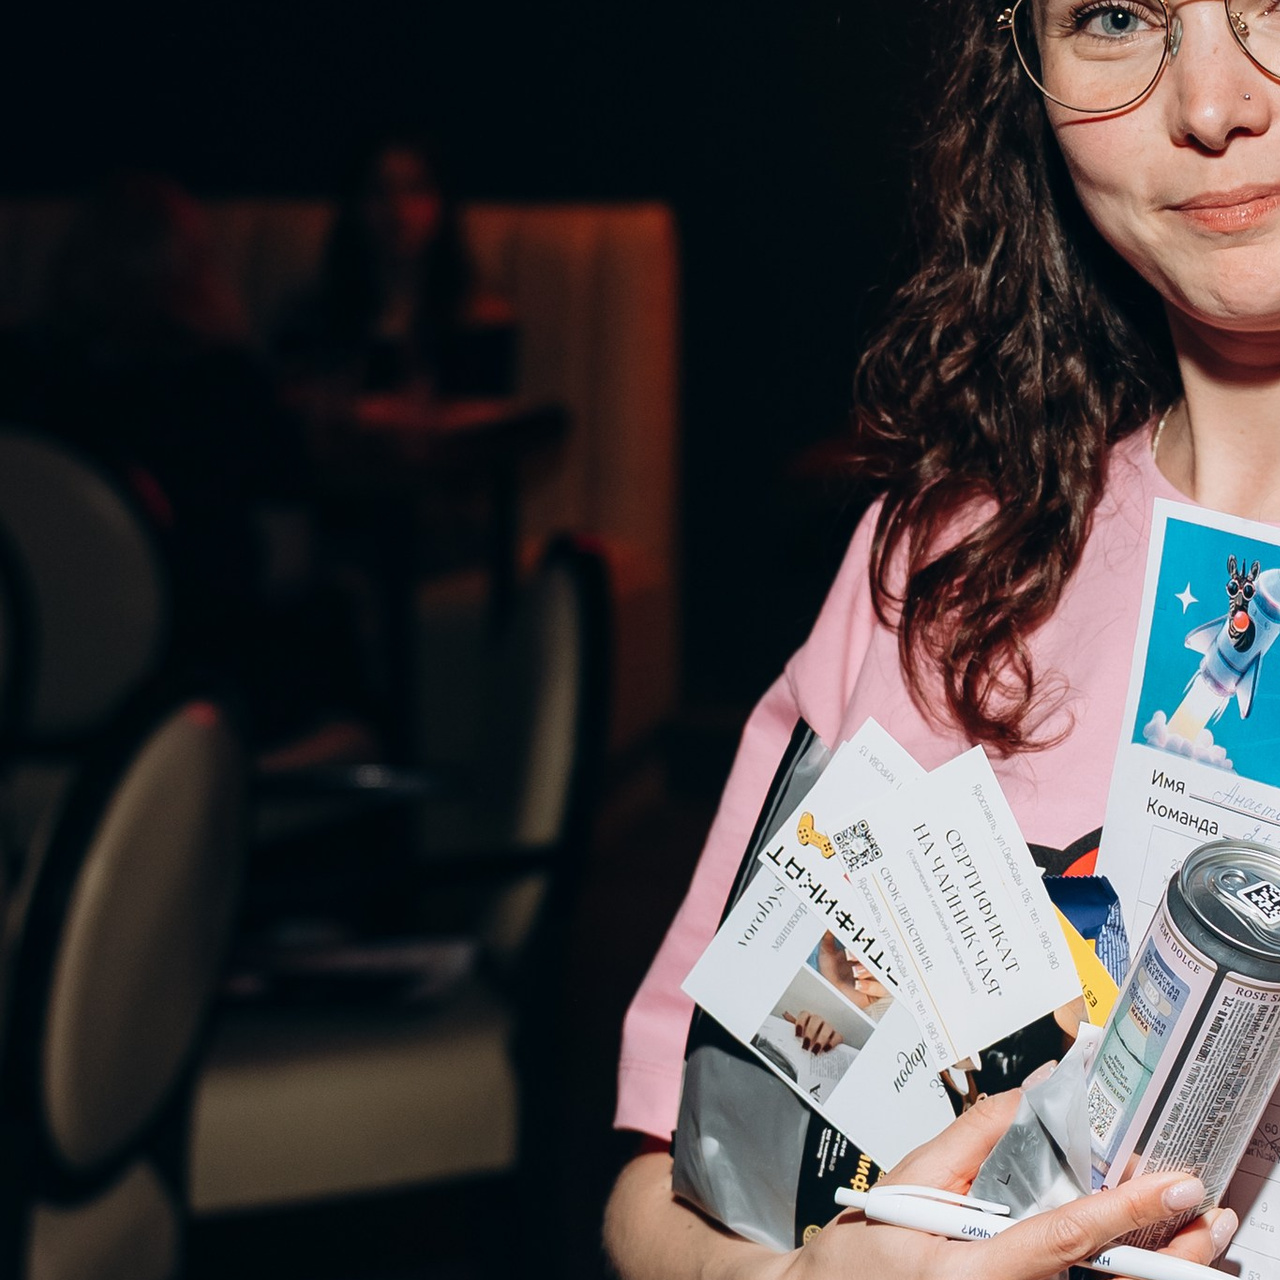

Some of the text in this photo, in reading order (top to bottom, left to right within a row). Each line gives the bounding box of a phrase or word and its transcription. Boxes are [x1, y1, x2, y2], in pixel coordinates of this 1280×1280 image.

[1151, 769, 1186, 795] Имя
[1147, 797, 1219, 836] Команда
[911, 820, 938, 856] НА
[927, 854, 983, 949] ЧАЙНИК
[943, 826, 1021, 976] СЕРТИФИКАТ
[730, 875, 794, 951] vorobys
[765, 837, 907, 992] ТИФИКАТ
[768, 900, 811, 953] маникюр
[878, 865, 936, 974] СРОК ДЕЙСТВИЯ:
[1035, 930, 1062, 970] 990-990
[1169, 940, 1202, 975] DOLCE
[1235, 984, 1268, 1002] ROSE
[1129, 1006, 1148, 1032] МАРКА
[922, 1020, 949, 1062] 990-990
[879, 1032, 938, 1097] подар
[1264, 1122, 1279, 1135] 60
[1249, 1216, 1275, 1233] Бста
[1261, 1201, 1268, 1213] 9
[960, 1223, 997, 1241] ЧКИ?
